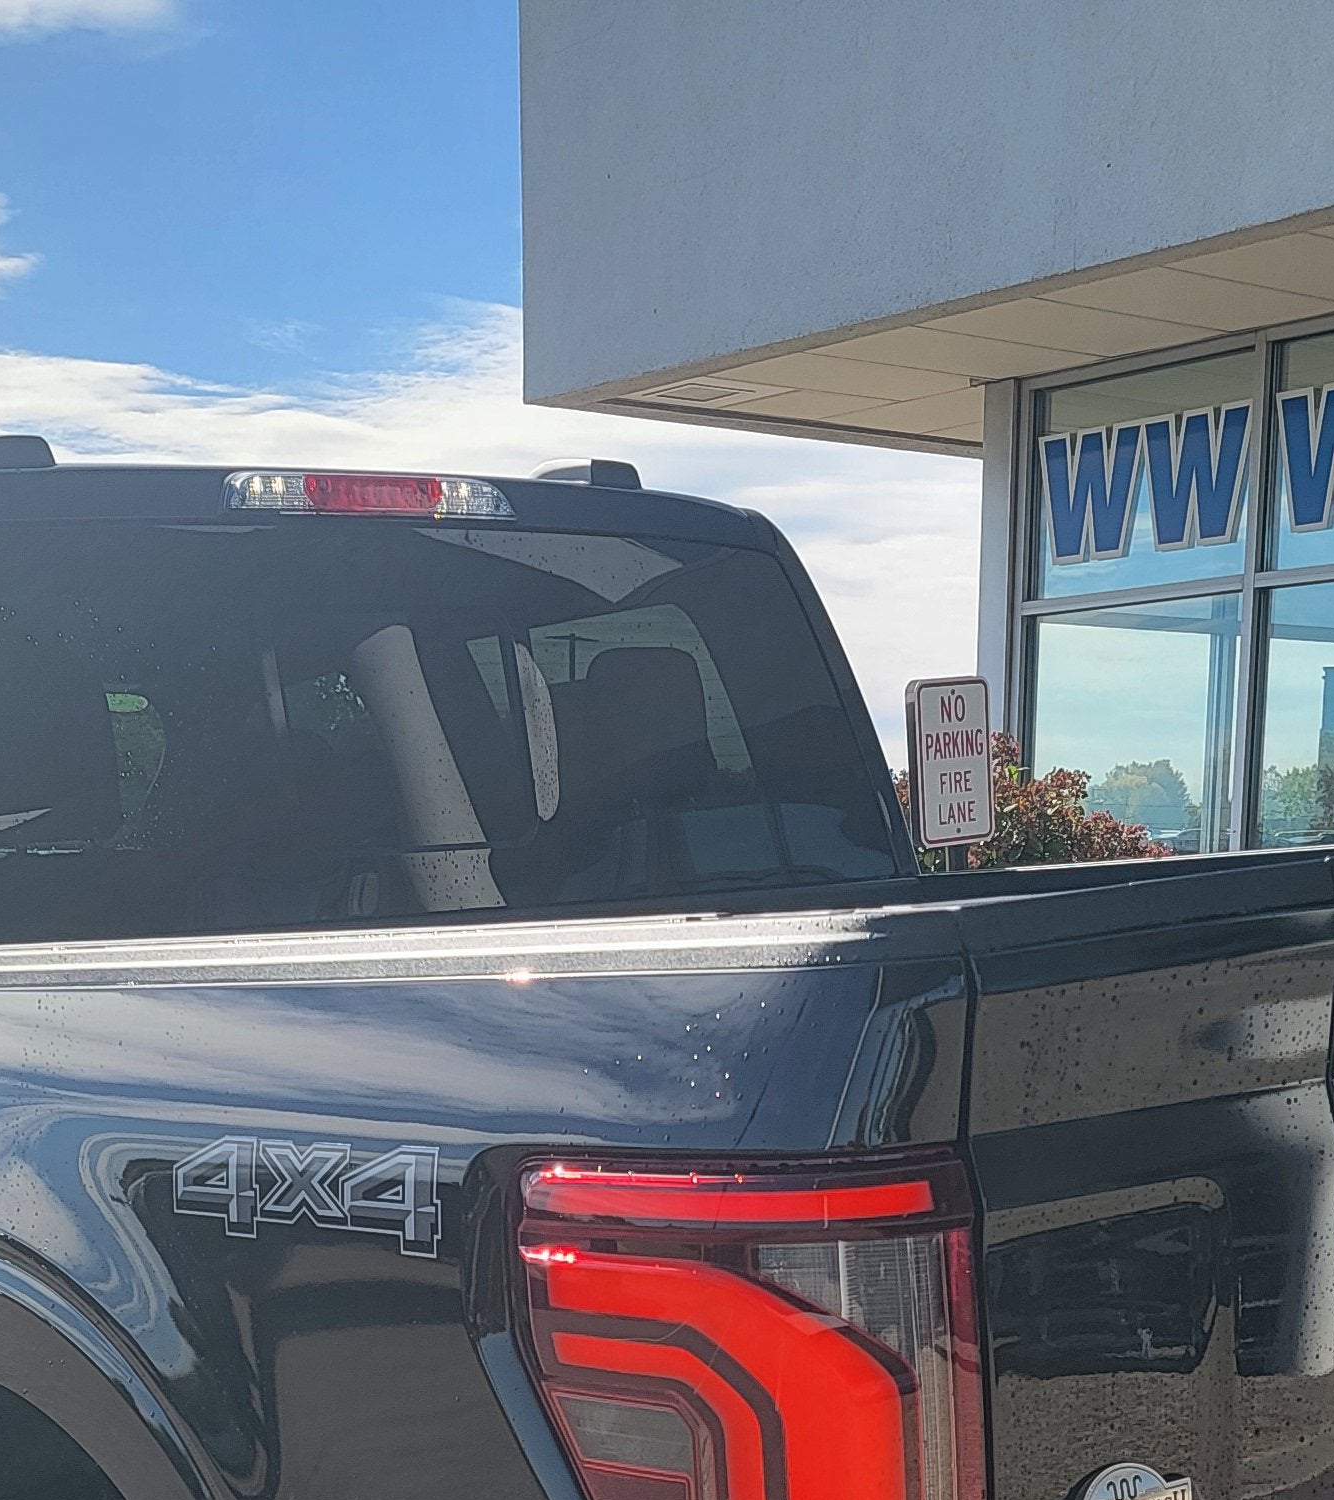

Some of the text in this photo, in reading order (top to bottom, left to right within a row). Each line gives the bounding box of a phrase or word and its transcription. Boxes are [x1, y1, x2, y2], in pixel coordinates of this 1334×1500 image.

[940, 694, 966, 724] NO
[925, 728, 984, 761] PARKING
[939, 770, 973, 795] FIRE
[938, 800, 977, 826] LANE
